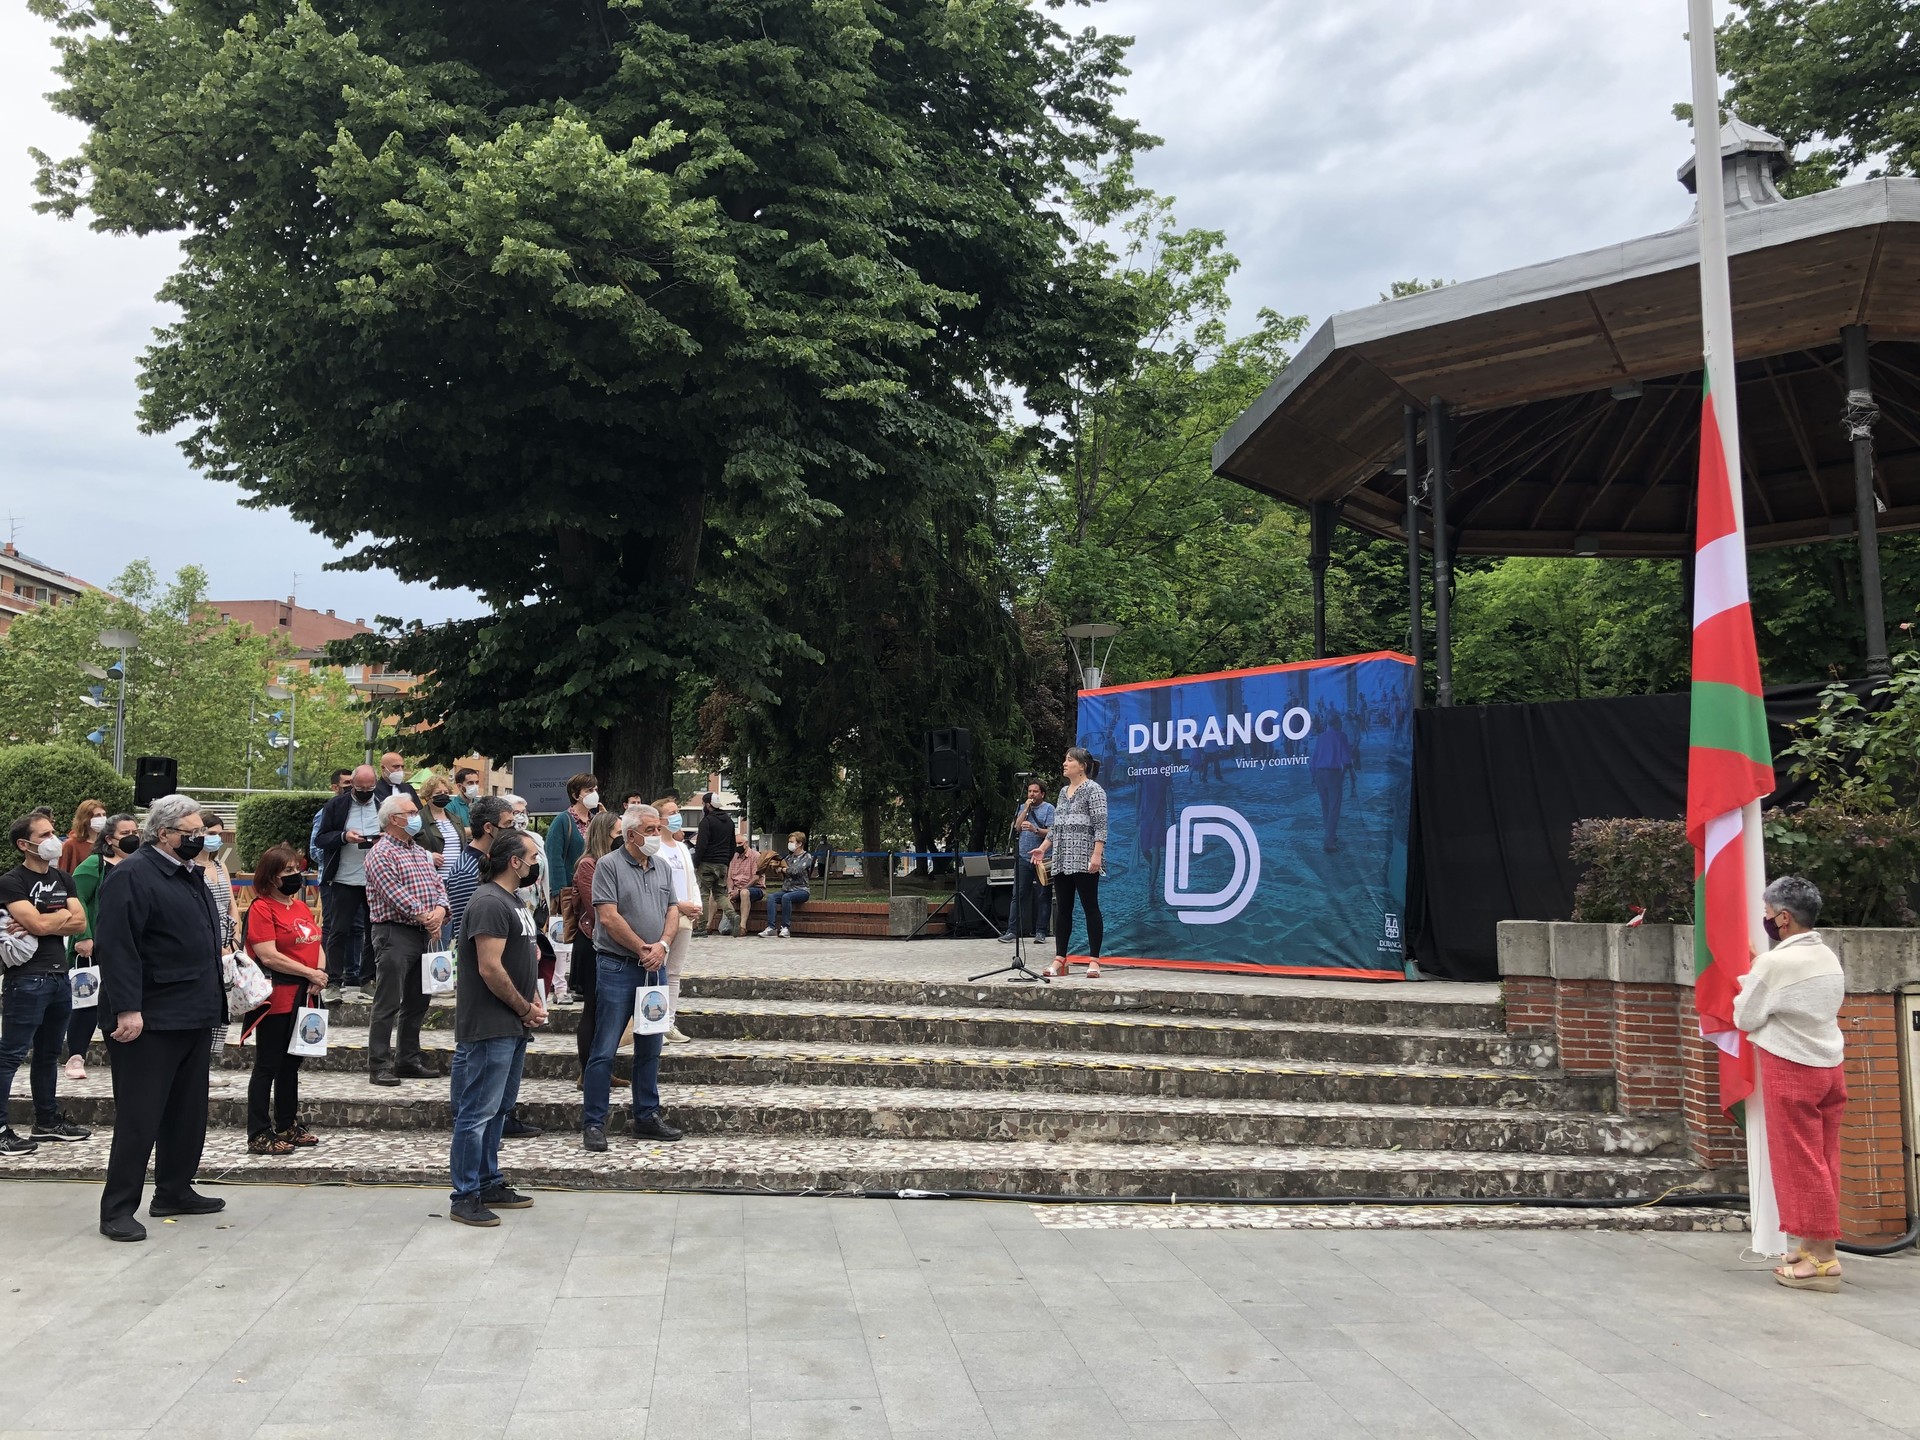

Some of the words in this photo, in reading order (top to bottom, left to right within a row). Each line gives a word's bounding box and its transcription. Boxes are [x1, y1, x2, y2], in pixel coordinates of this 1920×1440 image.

[1128, 706, 1312, 754] DURANGO
[1127, 766, 1158, 777] Garena
[1160, 764, 1190, 778] eginez
[1235, 757, 1259, 769] Vivir
[1259, 758, 1267, 771] y
[1268, 754, 1310, 767] convivir
